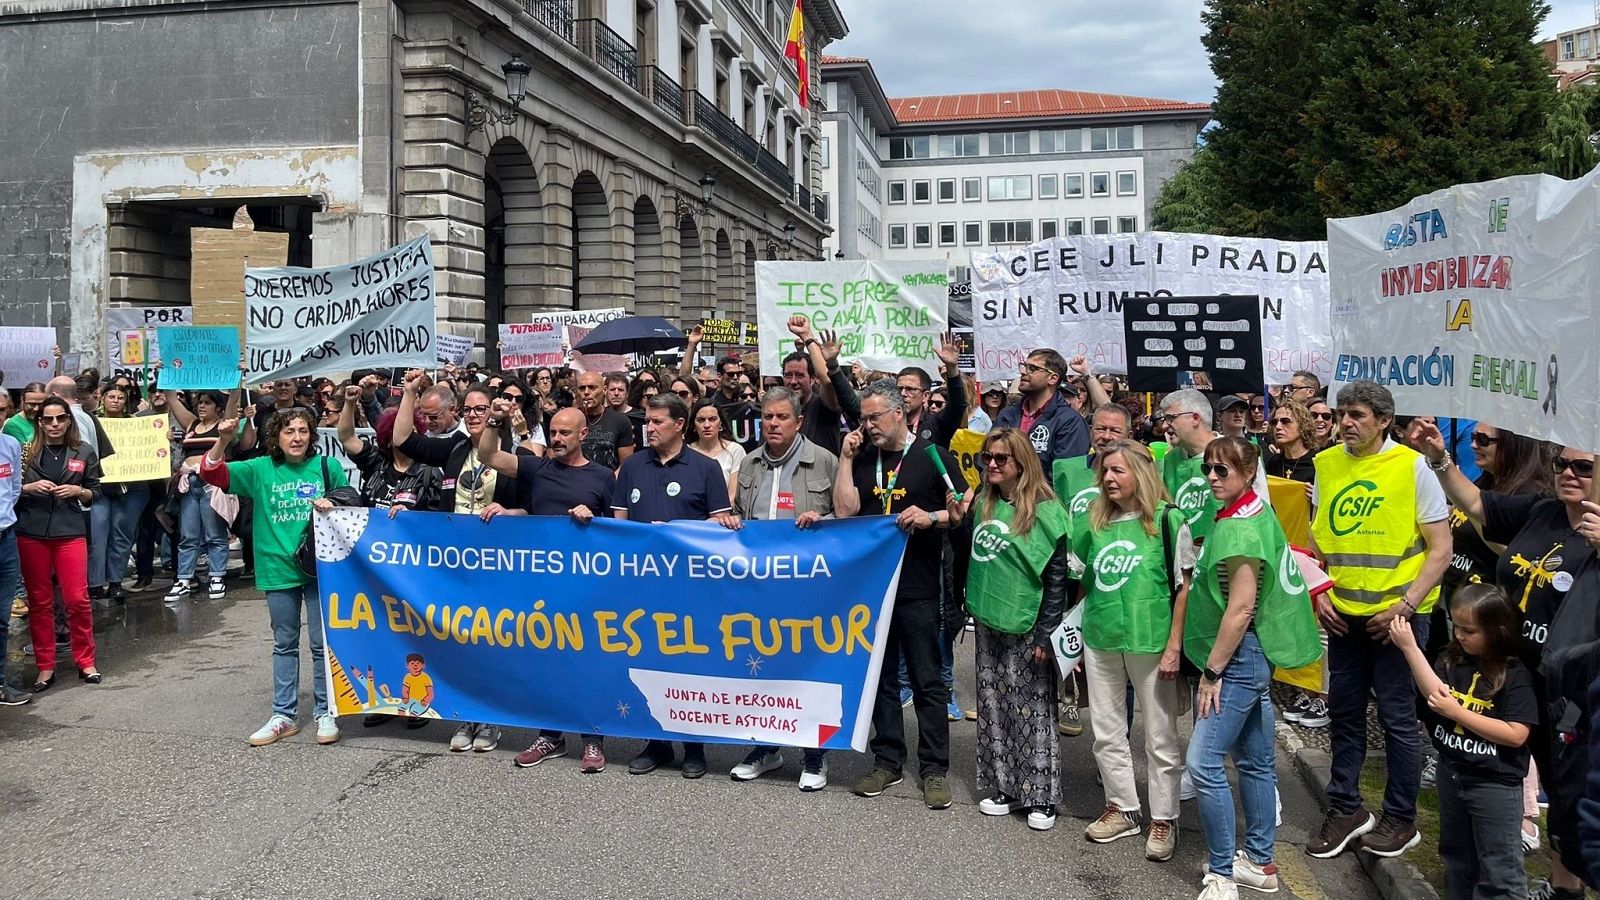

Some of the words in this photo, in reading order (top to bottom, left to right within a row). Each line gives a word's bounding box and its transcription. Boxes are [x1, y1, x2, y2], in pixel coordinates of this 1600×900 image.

[1383, 208, 1448, 251] BASTA
[1487, 196, 1510, 234] DE
[1010, 247, 1078, 277] CEE
[1191, 244, 1327, 274] PRADA
[244, 271, 333, 299] QUEREMOS
[775, 282, 838, 308] IES
[144, 308, 184, 323] POR
[250, 305, 284, 329] NO
[982, 295, 1033, 321] SIN
[1445, 299, 1473, 331] LA
[350, 324, 430, 356] DIGNIDAD
[703, 326, 740, 335] UENTAN
[1268, 347, 1333, 374] RECURS
[1334, 346, 1455, 387] EDUCACIÓN
[1179, 489, 1211, 510] CSIF
[1338, 496, 1386, 517] CSIF
[975, 529, 1011, 553] CSIF
[368, 541, 422, 567] SIN
[427, 545, 565, 574] DOCENTES
[571, 551, 612, 576] NO
[619, 553, 680, 577] HAY
[688, 554, 832, 580] ESCUELA
[1100, 554, 1144, 574] CSIF
[328, 592, 376, 631] LA
[381, 594, 584, 651] EDUCACIÓN
[592, 608, 646, 657] ES
[652, 612, 710, 655] EL
[718, 603, 878, 661] FUTUR
[1063, 625, 1081, 652] CSIF
[664, 687, 707, 704] JUNTA
[711, 692, 731, 705] DE
[735, 695, 803, 710] PERSONAL
[669, 708, 732, 725] DOCENTE
[735, 713, 798, 733] ASTURIAS
